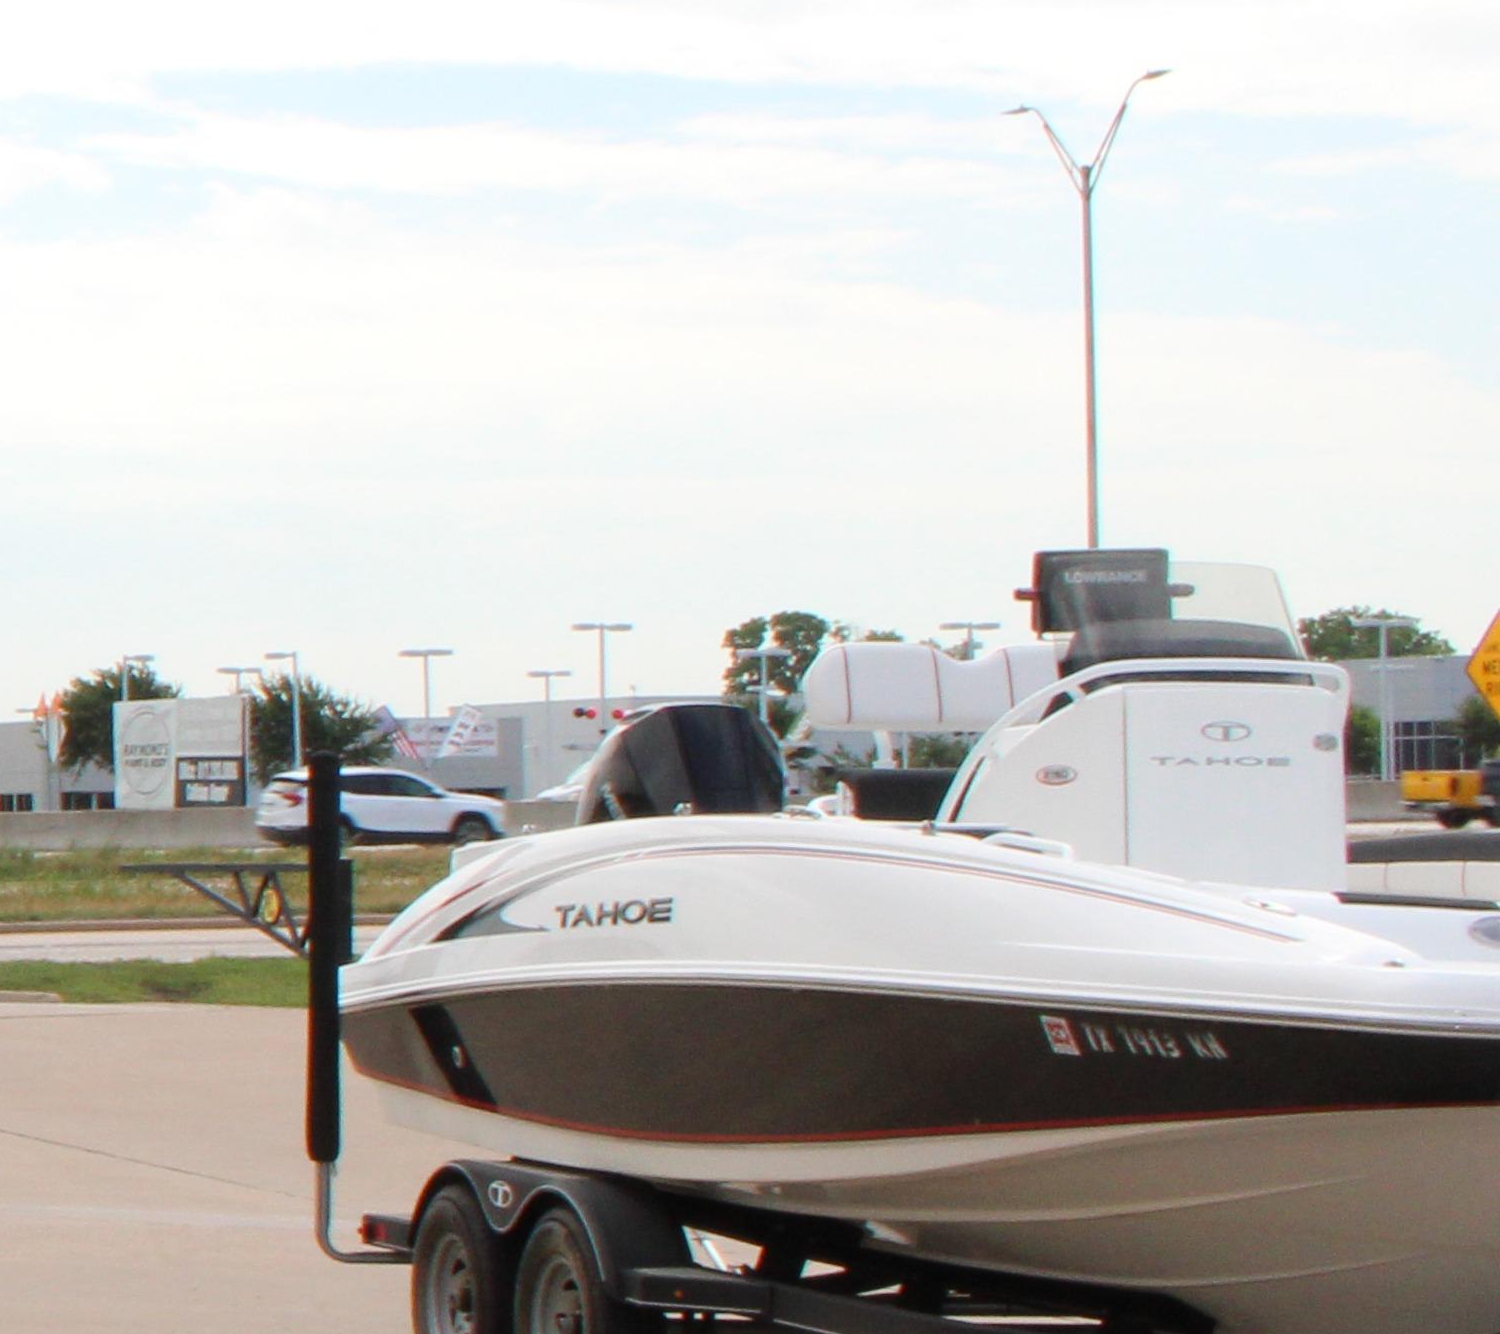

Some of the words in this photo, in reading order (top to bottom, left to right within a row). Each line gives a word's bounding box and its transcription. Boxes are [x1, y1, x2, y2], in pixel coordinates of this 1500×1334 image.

[1064, 570, 1149, 584] LOWRANCE
[1150, 755, 1291, 767] TAHOE
[555, 896, 674, 929] TAHOE
